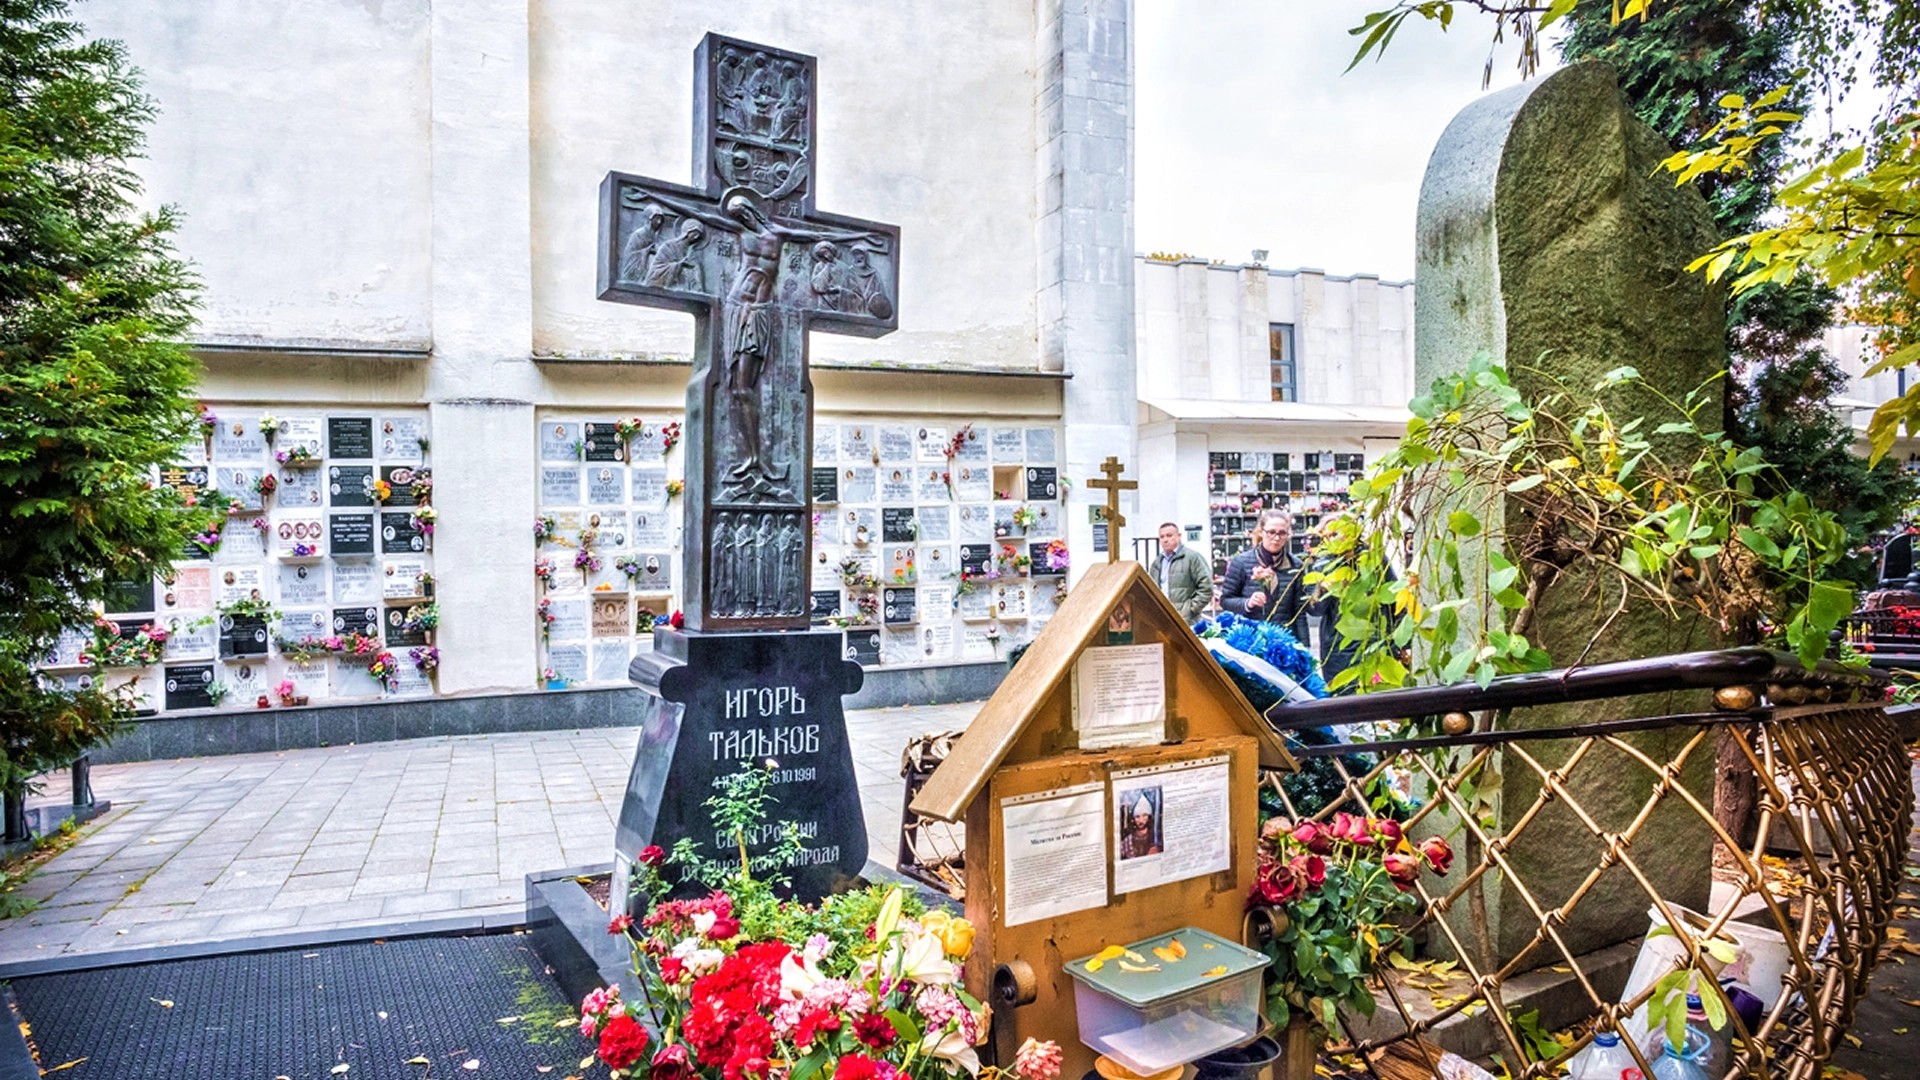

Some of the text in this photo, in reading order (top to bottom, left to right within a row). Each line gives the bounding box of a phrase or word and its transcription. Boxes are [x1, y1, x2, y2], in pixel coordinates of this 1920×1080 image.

[725, 686, 806, 719] ИГОРЬ
[708, 724, 820, 760] ТАЛЬКОВ
[763, 821, 818, 843] РОИИ
